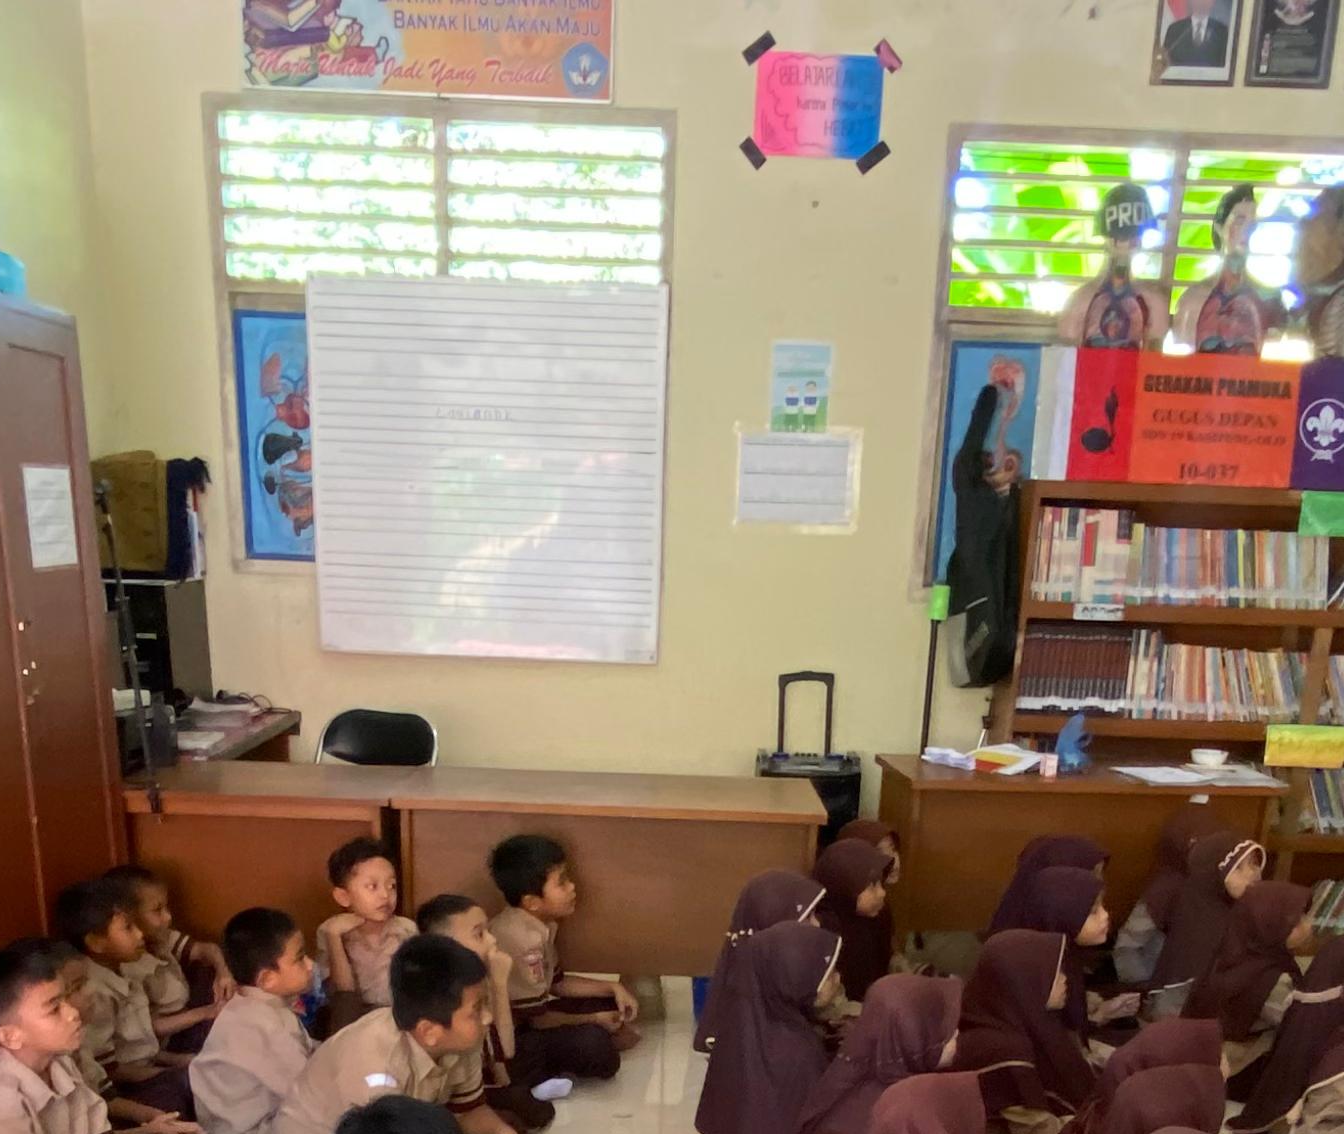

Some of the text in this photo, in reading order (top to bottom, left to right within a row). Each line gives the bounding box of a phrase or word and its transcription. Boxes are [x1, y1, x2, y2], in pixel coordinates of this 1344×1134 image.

[394, 10, 600, 36] BANYAK ILMU AKAN MAJU
[383, 56, 425, 85] Jadi
[429, 58, 477, 88] Yang
[1144, 374, 1291, 399] GERAKAN PRAMUKA
[1219, 411, 1279, 428] DEPAN
